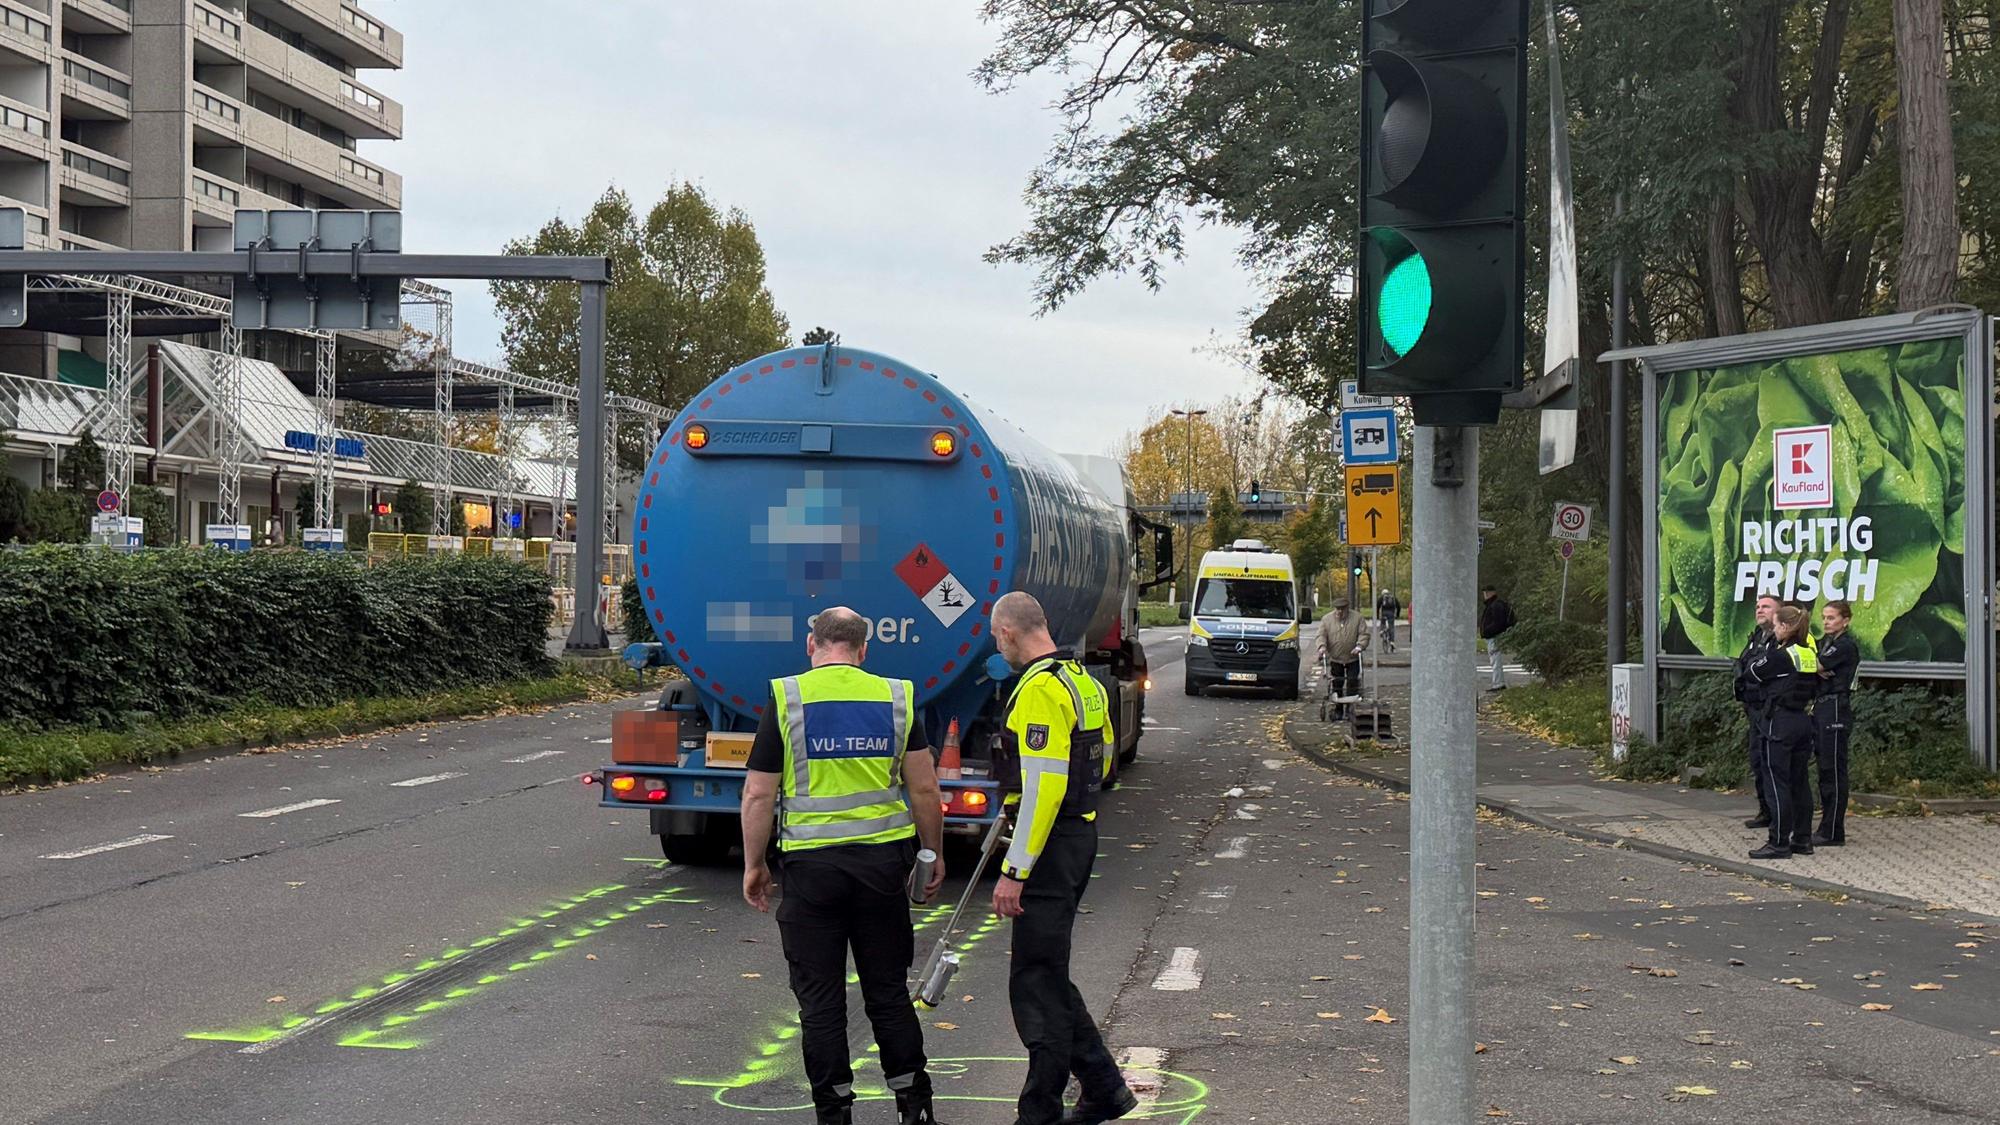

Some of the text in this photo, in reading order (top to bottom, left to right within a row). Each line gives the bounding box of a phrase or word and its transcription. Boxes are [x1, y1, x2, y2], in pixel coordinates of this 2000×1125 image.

[721, 431, 797, 444] SCHRADER
[1782, 480, 1824, 494] Kaufland
[1565, 512, 1580, 525] 30
[1560, 530, 1580, 539] ZONE
[1743, 515, 1873, 555] RICHTIG
[1213, 572, 1280, 580] UNFALLAUFNAHME
[1734, 558, 1879, 602] FRISCH
[1217, 623, 1269, 632] POLIZEI
[845, 737, 889, 751] TEAM
